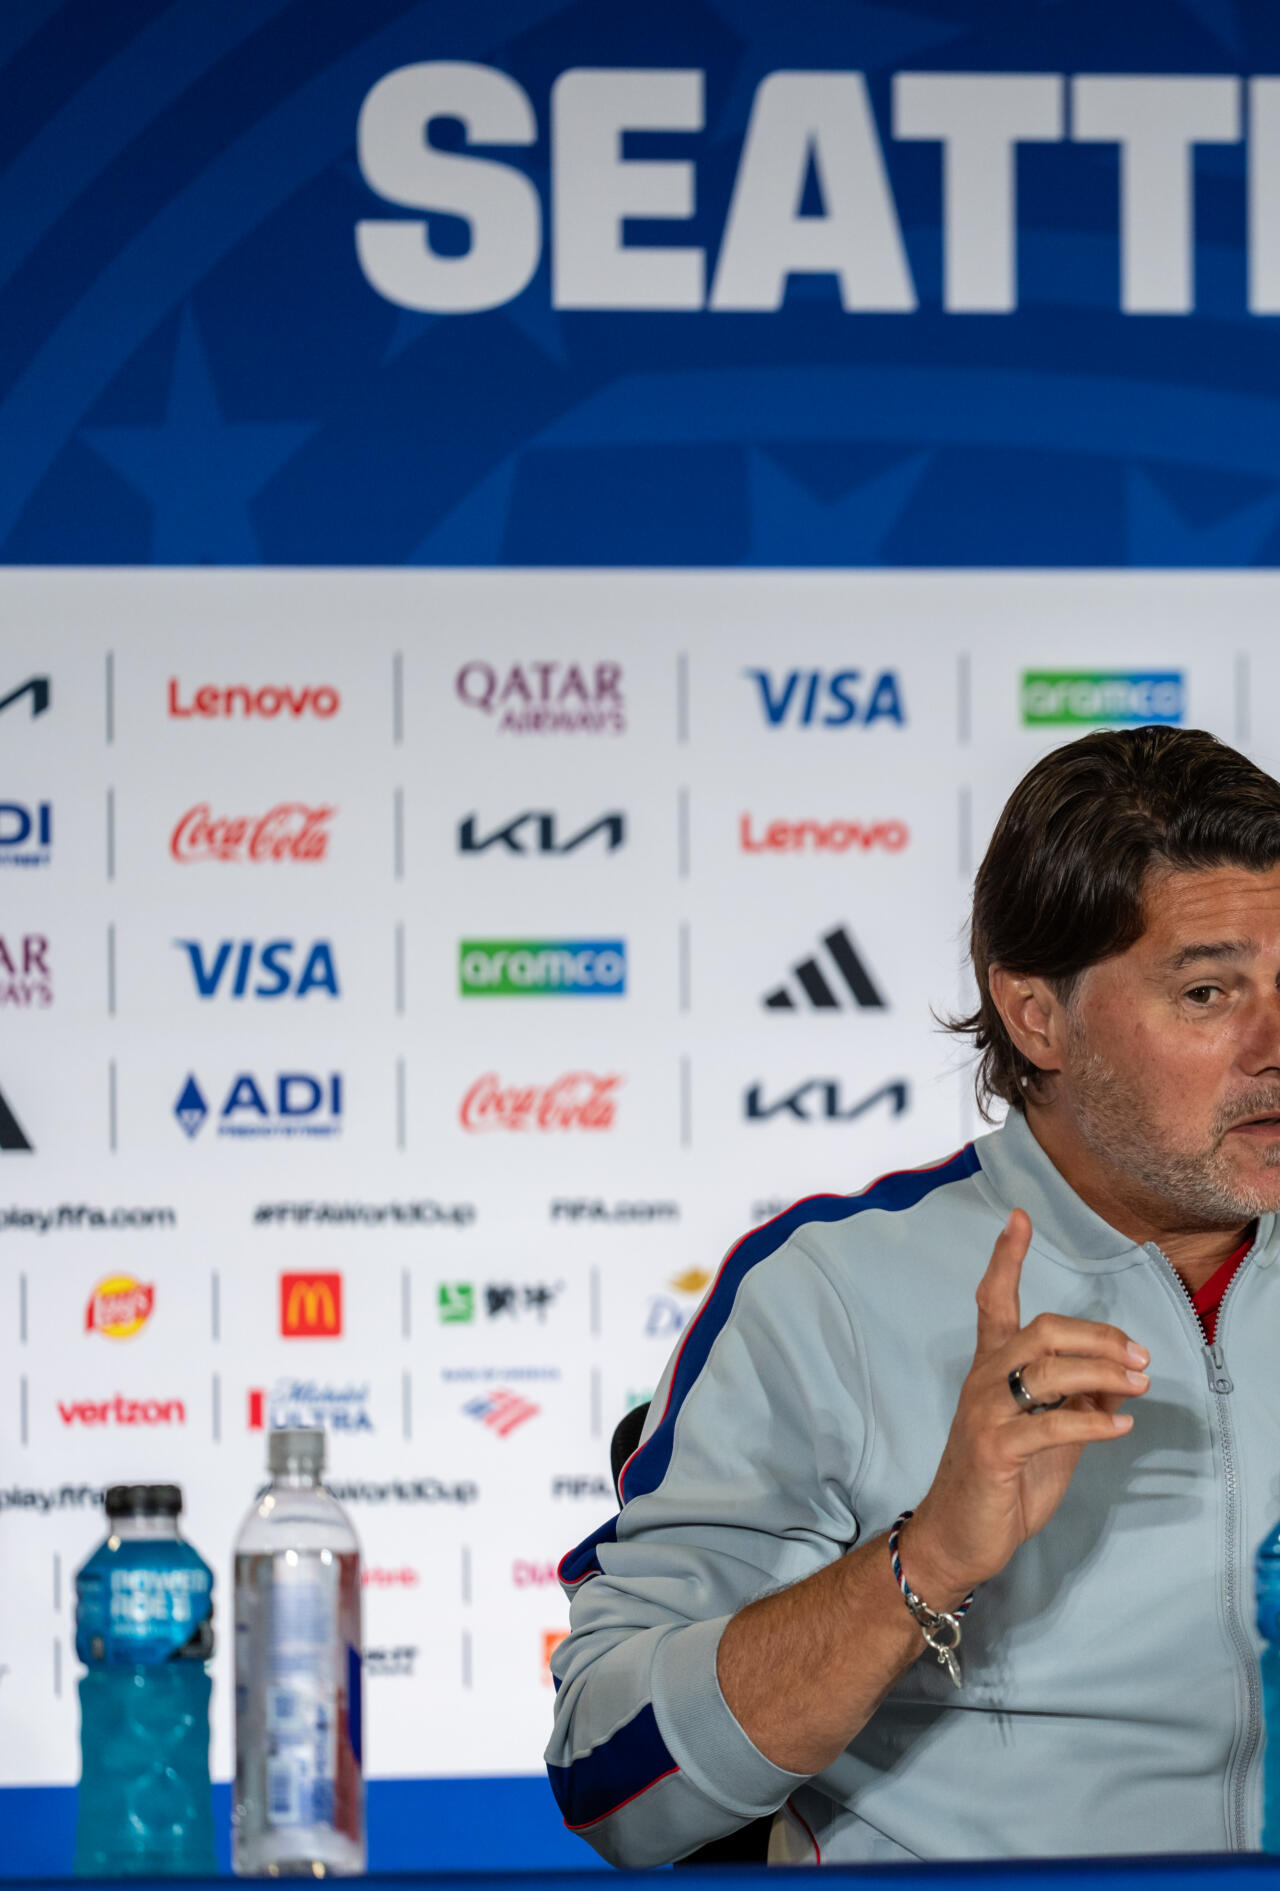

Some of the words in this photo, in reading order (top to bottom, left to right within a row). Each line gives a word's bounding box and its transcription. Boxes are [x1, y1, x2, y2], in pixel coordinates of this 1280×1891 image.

[168, 677, 340, 719] Lenovo
[455, 661, 624, 711] QATAR
[746, 669, 906, 728] VISA
[1023, 675, 1182, 714] aramco
[0, 802, 51, 848] DI
[458, 812, 626, 855] KIA
[739, 813, 910, 854] Lenovo
[175, 939, 340, 999] VISA
[462, 950, 624, 986] aramco
[220, 1072, 342, 1117] ADI
[744, 1079, 910, 1122] KIA
[57, 1394, 186, 1426] verizon
